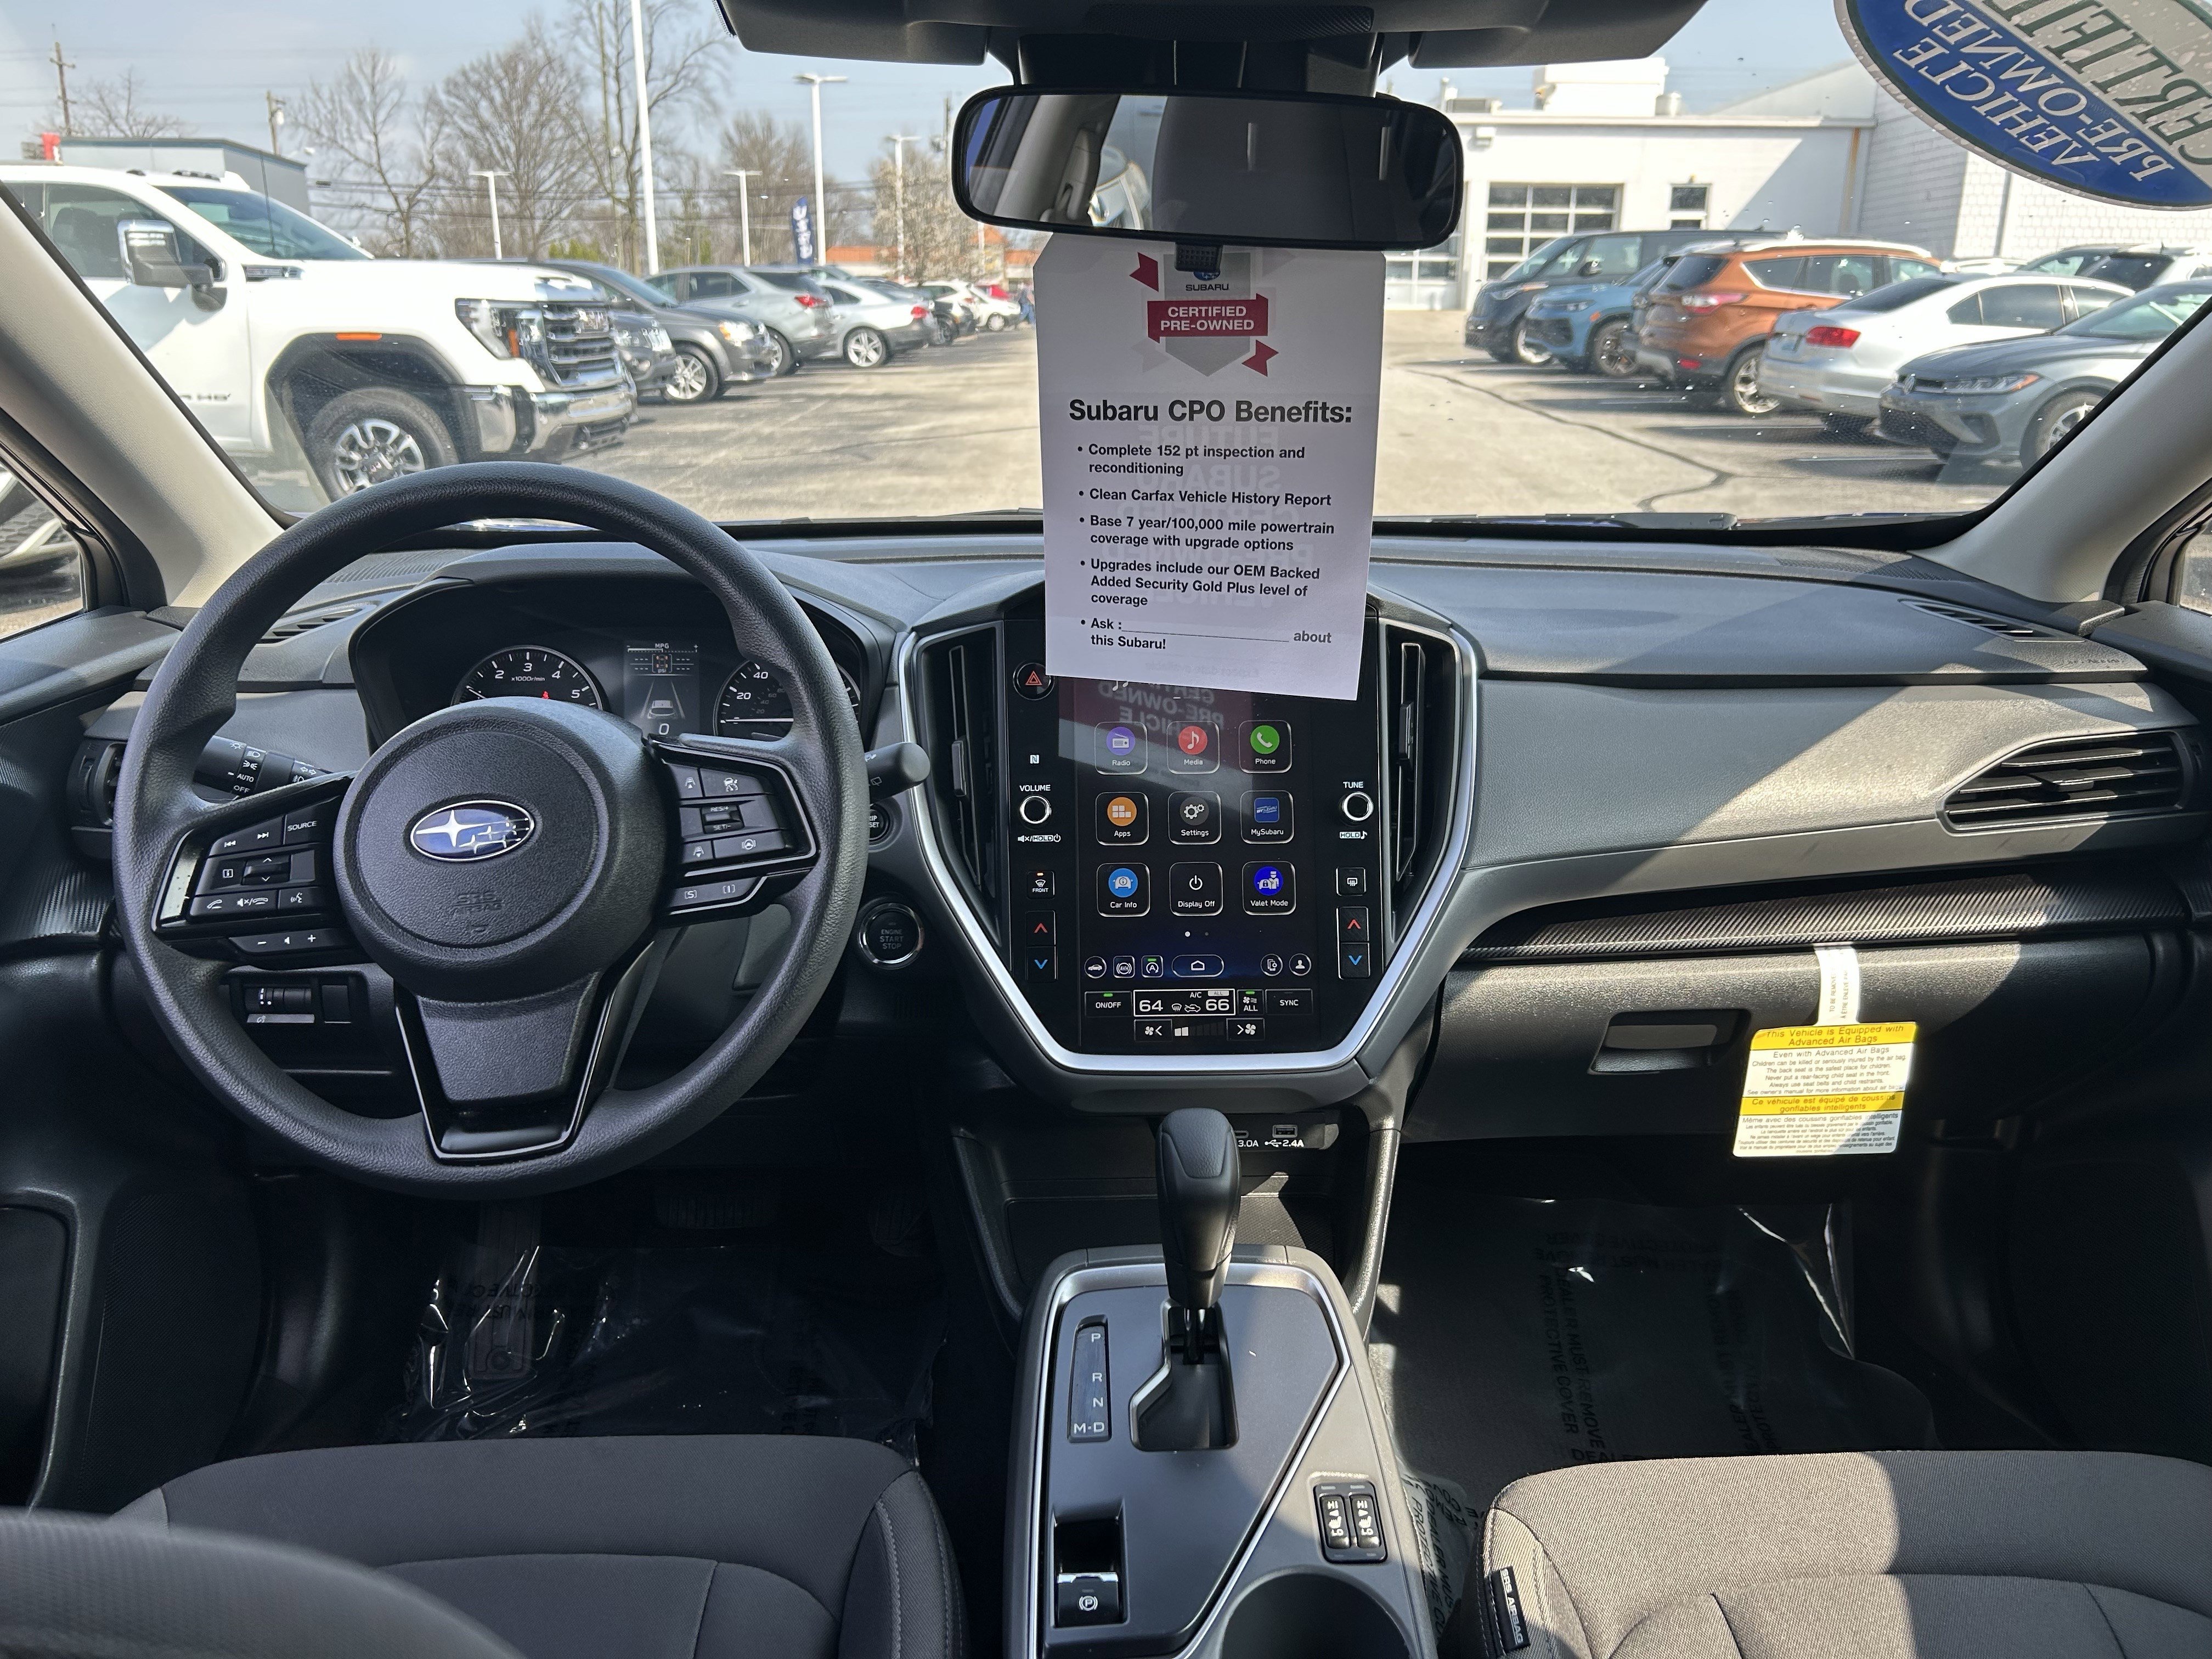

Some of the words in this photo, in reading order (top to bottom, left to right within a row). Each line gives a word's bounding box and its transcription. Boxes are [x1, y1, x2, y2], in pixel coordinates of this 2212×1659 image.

[1186, 283, 1229, 291] SUBARU
[1167, 306, 1246, 318] CERTIFIED
[1160, 320, 1254, 331] PRE-OWNED
[1069, 399, 1158, 422] Subaru
[1168, 399, 1226, 422] CPO
[1235, 400, 1352, 424] Benefits:
[1088, 443, 1152, 458] Complete
[1158, 445, 1181, 456] 152
[1186, 445, 1199, 459] pt
[1204, 445, 1274, 460] inspection
[1279, 447, 1305, 459] and
[1089, 462, 1184, 477] reconditioning
[1090, 488, 1126, 500] Clean
[1131, 489, 1175, 501] Carfax
[1178, 490, 1227, 503] Vehicle
[1231, 492, 1280, 506] History
[1284, 493, 1331, 507] Report
[1090, 515, 1122, 527] Base
[1126, 516, 1134, 527] 7
[1139, 517, 1223, 532] year/100,000
[1228, 520, 1256, 531] mile
[1261, 522, 1334, 534] powertrain
[1091, 534, 1149, 548] coverage
[1153, 535, 1180, 546] with
[1186, 537, 1239, 549] upgrade
[1244, 538, 1294, 551] options
[1091, 558, 1152, 572] Upgrades
[1156, 561, 1203, 574] include
[1207, 566, 1229, 575] our
[1234, 565, 1265, 577] OEM
[1270, 566, 1320, 579] Backed
[1091, 575, 1131, 588] Added
[1135, 577, 1188, 592] Security
[1193, 580, 1222, 592] Gold
[1227, 582, 1255, 594] Plus
[1260, 583, 1289, 596] level
[1294, 585, 1308, 596] of
[1091, 594, 1148, 607] coverage
[1091, 618, 1114, 629] Ask
[1293, 630, 1332, 643] about
[1091, 634, 1114, 646] this
[1118, 636, 1166, 650] Subaru!
[523, 663, 533, 672] 3
[494, 670, 504, 679] 2
[551, 670, 561, 679] 4
[571, 689, 580, 698] 5
[659, 723, 670, 736] 0
[237, 774, 254, 782] AUTO
[233, 785, 251, 793] OFF
[287, 821, 318, 832] SOURCE
[1181, 829, 1209, 837] Settings
[1139, 1000, 1164, 1012] 64
[1205, 998, 1230, 1011] 66
[1790, 1029, 1823, 1037] Vehicle
[1839, 1026, 1882, 1035] Equipped
[1788, 1037, 1835, 1046] Advanced
[1855, 1035, 1877, 1045] Bags
[1819, 1096, 1846, 1104] équipé
[1780, 1105, 1821, 1114] gonflables
[1824, 1104, 1866, 1112] intelligents
[1091, 1333, 1101, 1343] P
[1092, 1372, 1103, 1383] R
[1093, 1397, 1104, 1408] N
[1328, 1500, 1339, 1510] HI
[1357, 1500, 1368, 1509] HI
[1331, 1528, 1344, 1537] LO
[1502, 1568, 1513, 1593] SRS
[1507, 1596, 1524, 1644] AIRBAG
